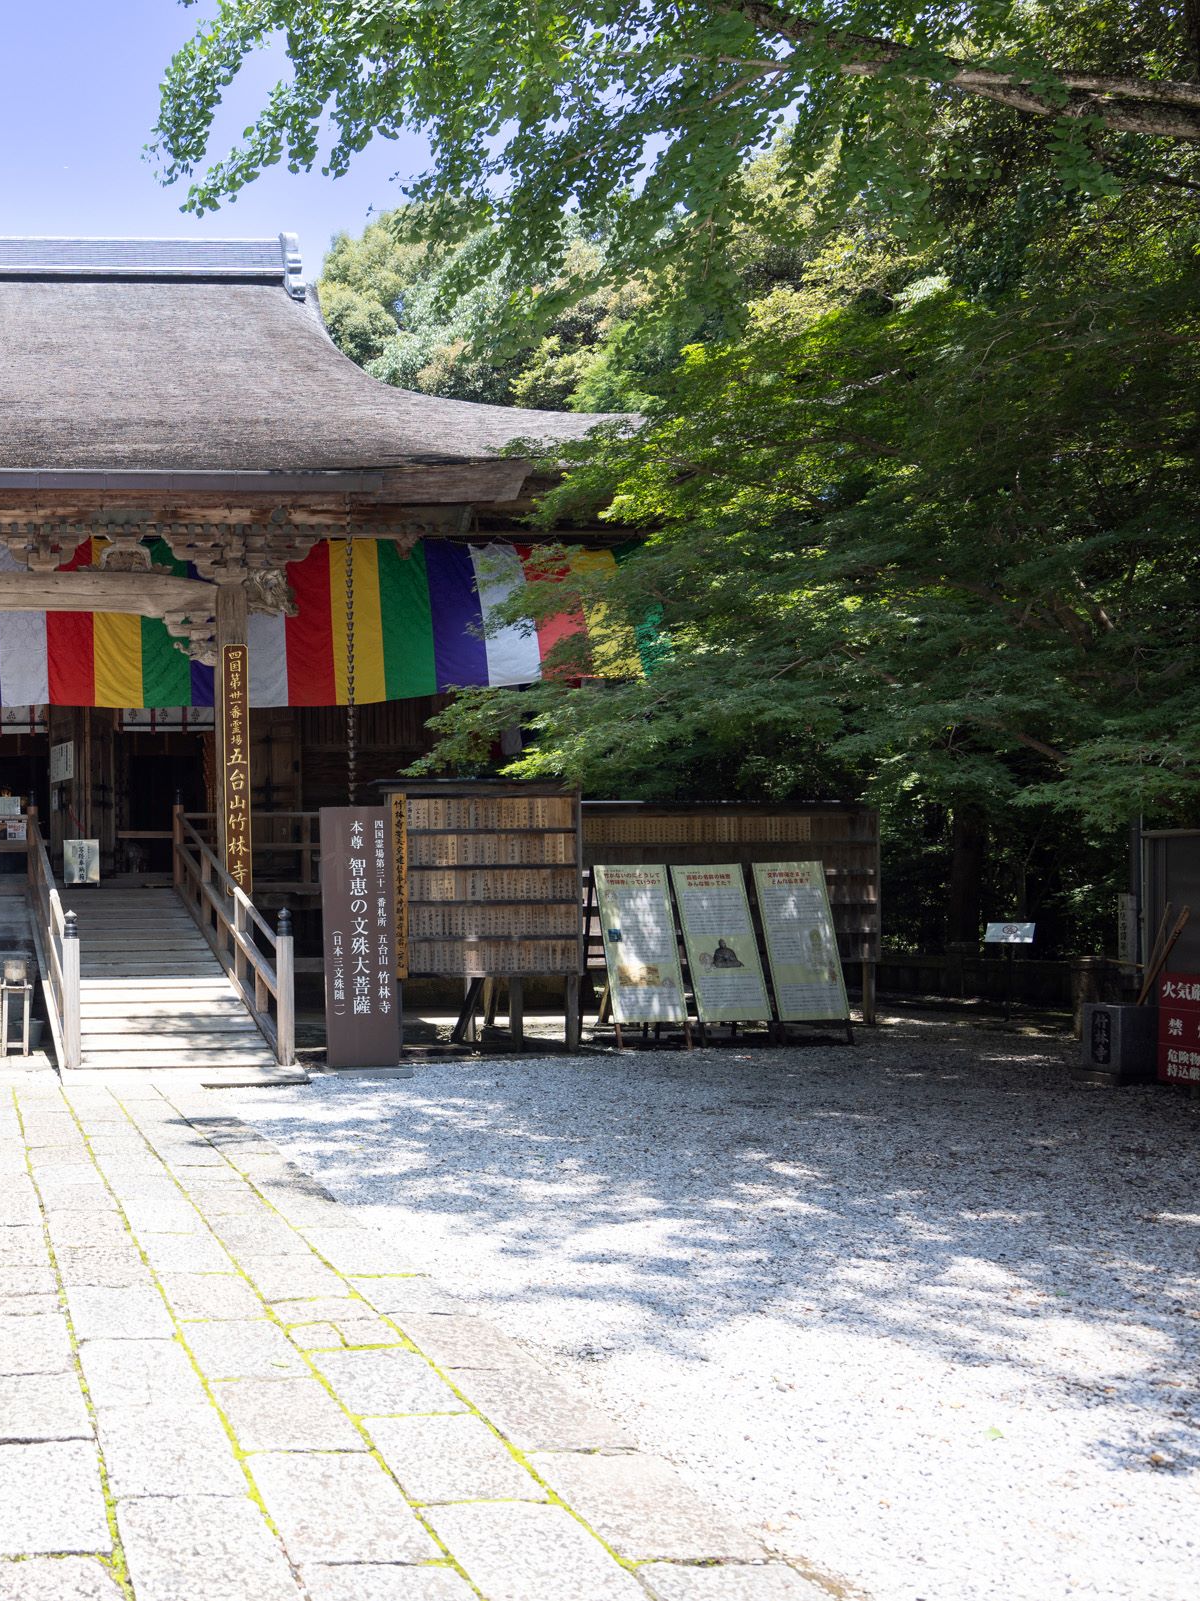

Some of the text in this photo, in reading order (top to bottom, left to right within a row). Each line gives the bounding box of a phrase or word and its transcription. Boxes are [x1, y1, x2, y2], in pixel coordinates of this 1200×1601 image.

[348, 821, 371, 1015] 本尊 智恵の文殊大菩薩
[374, 820, 391, 1014] 四国霊場第三十一番札所 五台山 竹林寺
